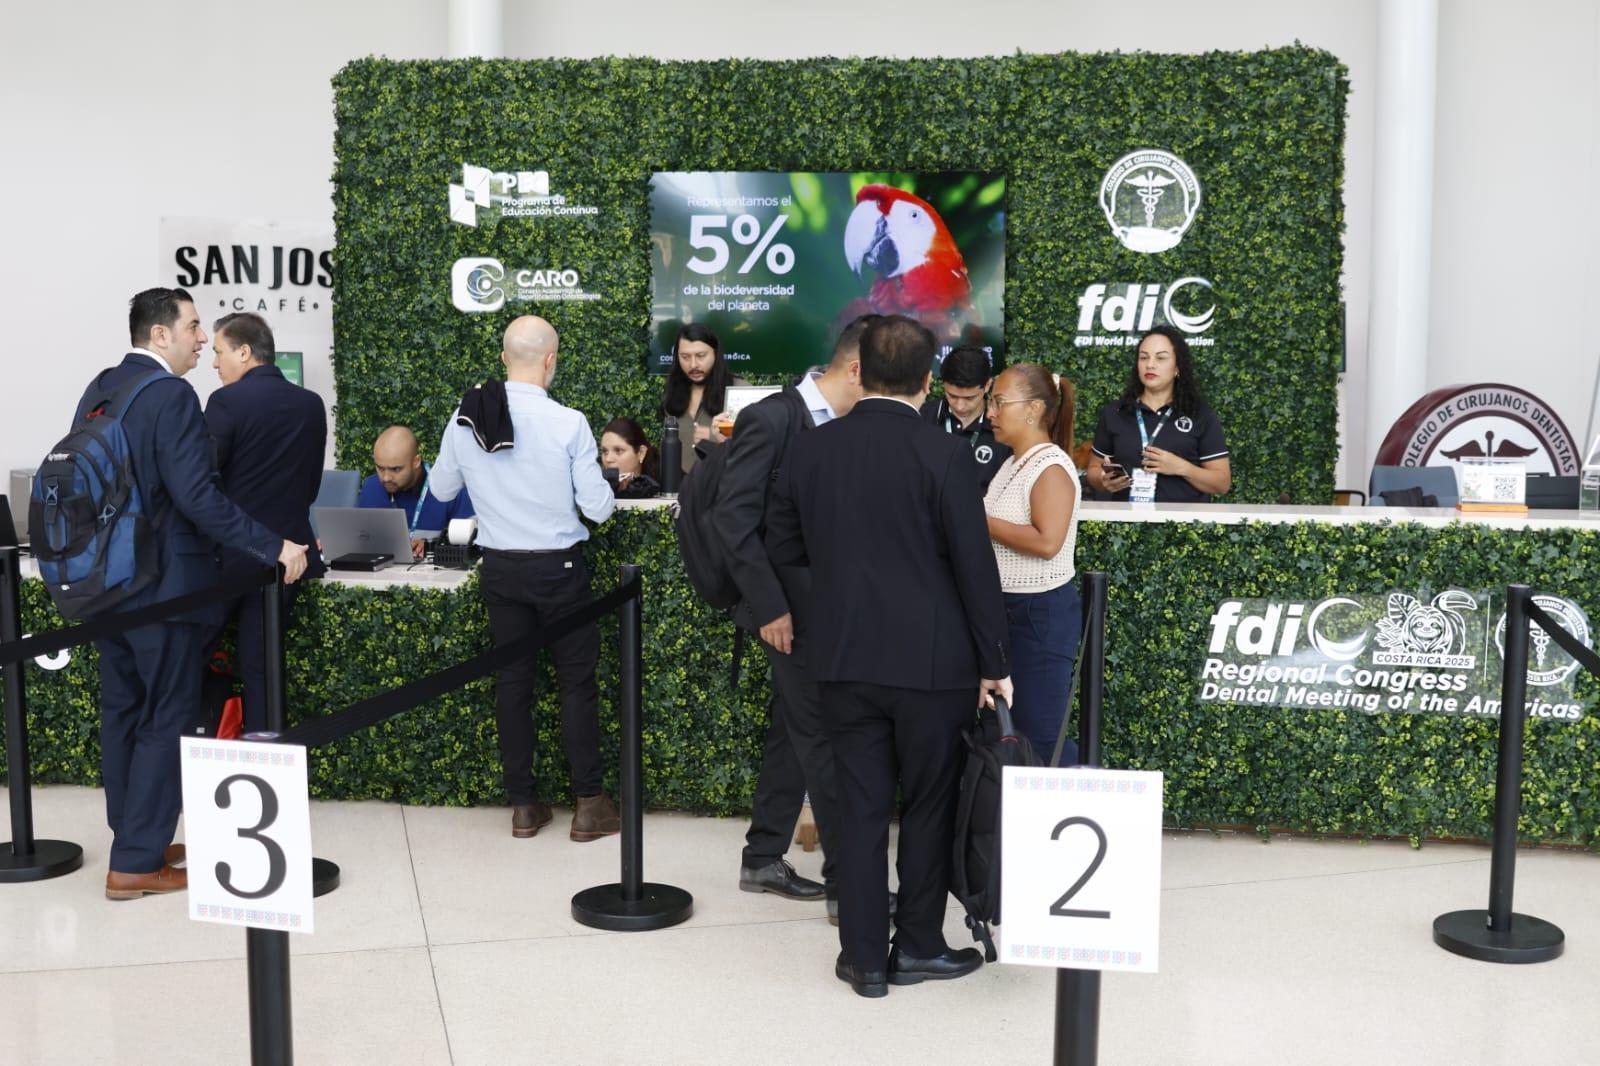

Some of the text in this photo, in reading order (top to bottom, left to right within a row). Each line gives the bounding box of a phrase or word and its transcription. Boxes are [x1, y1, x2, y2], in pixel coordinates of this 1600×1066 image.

[502, 207, 551, 216] Educación
[687, 195, 791, 208] Representamos el
[686, 214, 795, 274] 5%
[175, 245, 333, 290] SAN JOS
[517, 269, 579, 287] CARO
[232, 297, 306, 312] CAFÉ
[683, 284, 698, 295] de
[701, 284, 711, 295] la
[707, 299, 770, 312] del planeta
[1076, 284, 1160, 331] fdi
[1095, 336, 1122, 346] World
[1404, 393, 1575, 473] OLEGIO DE CIRUJANOS DENTISTAS
[1209, 601, 1304, 656] fdi
[1202, 658, 1468, 692] Regional Congress
[1376, 654, 1470, 666] COSTA RICA 2025
[1201, 683, 1581, 719] Dental Meeting of the Amricas
[214, 774, 286, 900] 3
[1050, 816, 1110, 919] 2
